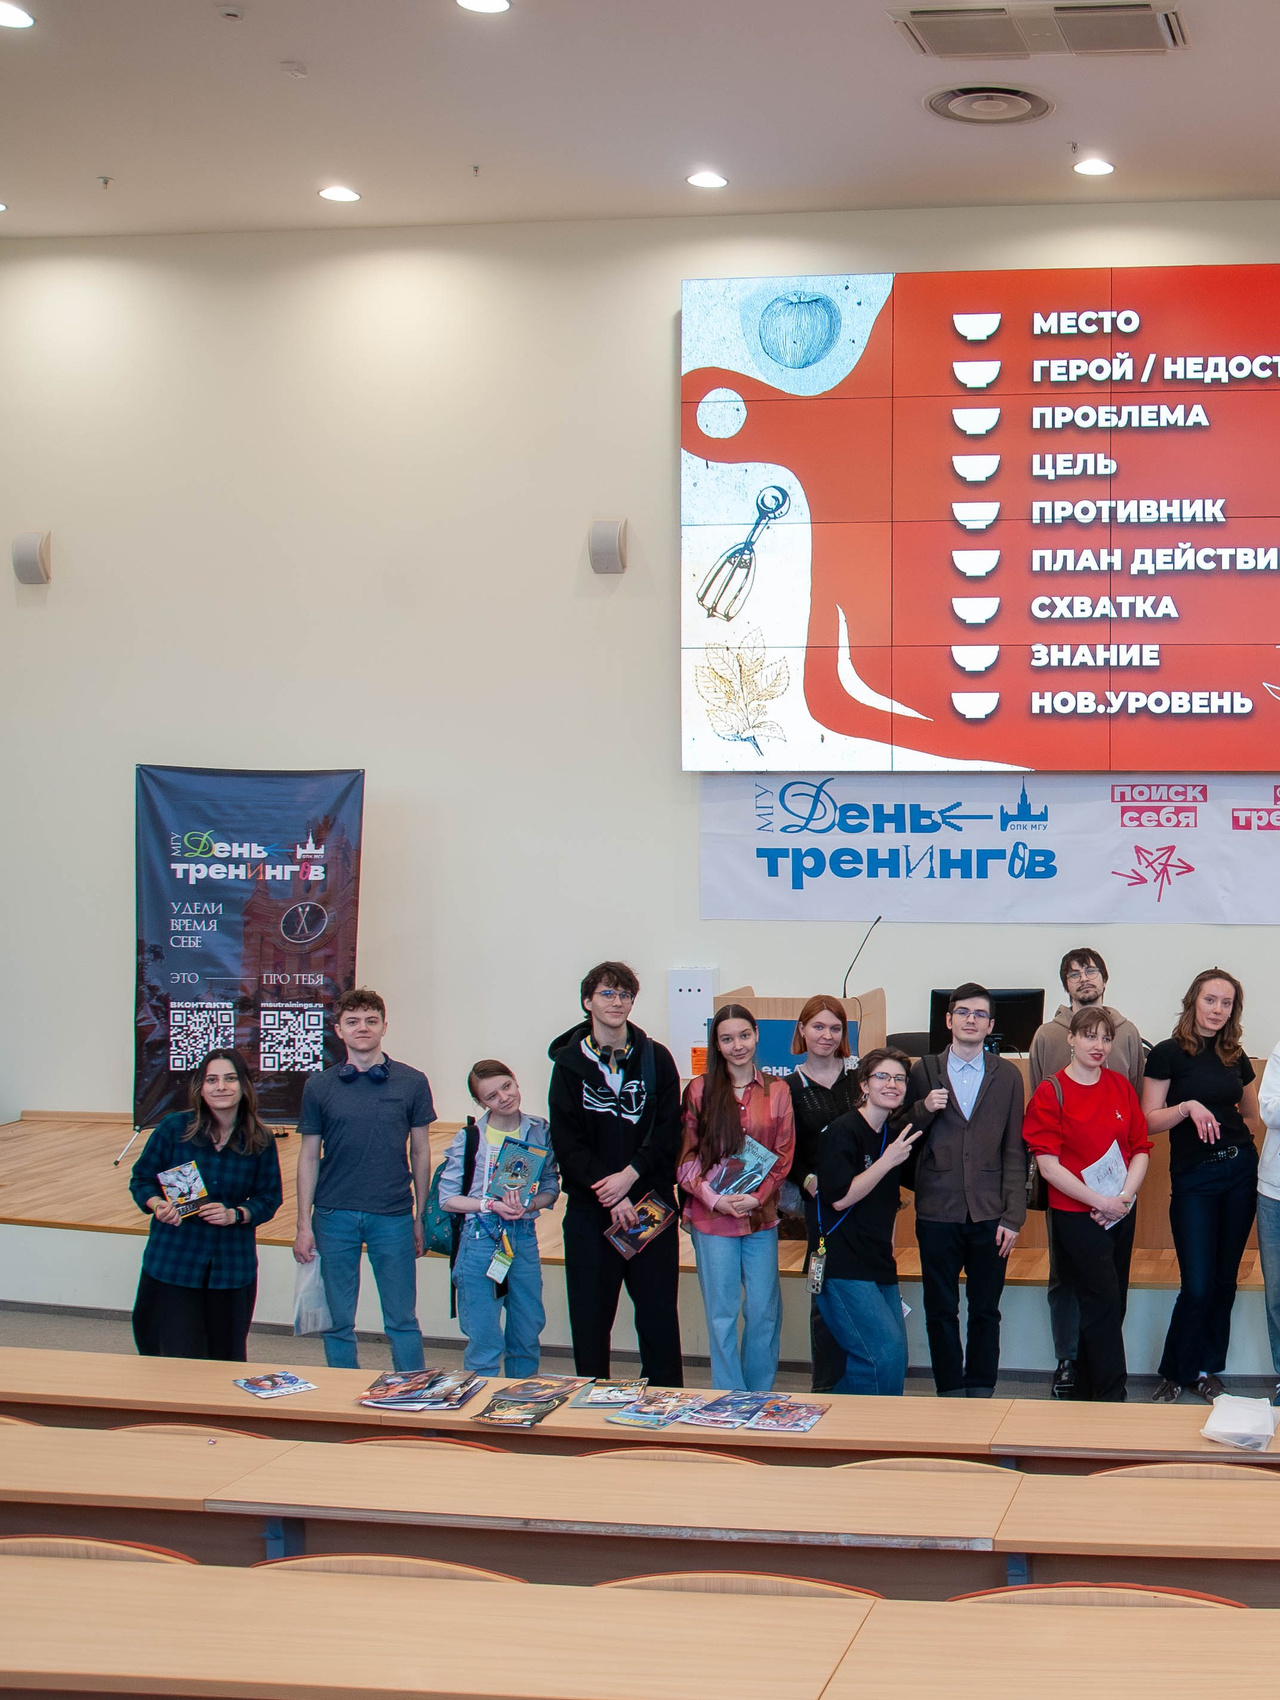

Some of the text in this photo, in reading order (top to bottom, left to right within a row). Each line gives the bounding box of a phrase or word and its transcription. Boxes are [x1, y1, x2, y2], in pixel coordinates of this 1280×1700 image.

[1034, 311, 1139, 334] МЕСТО
[1034, 351, 1133, 382] ГЕРОЙ
[1033, 405, 1210, 429] ПРОБЛЕМА
[1033, 454, 1117, 480] ЦЕЛЬ
[1033, 499, 1226, 524] ПРОТИВНИК
[1033, 549, 1122, 571] ПЛАН
[1032, 596, 1179, 619] СХВАТКА
[1031, 643, 1160, 667] ЗНАНИЕ
[1032, 691, 1253, 714] НОВ.УРОВЕНЬ
[755, 782, 774, 833] МГУ
[779, 777, 943, 834] День
[1122, 807, 1196, 827] себя
[171, 832, 182, 857] МГУ
[183, 829, 269, 858] День
[170, 902, 223, 915] УДЕЛИ
[170, 919, 218, 932] ВРЕМЯ
[169, 935, 203, 948] СЕБЕ
[170, 973, 324, 985] ЭТО ПРО ТЕБЯ
[260, 1001, 324, 1009] msutrainings.ru
[761, 1065, 794, 1077] ень
